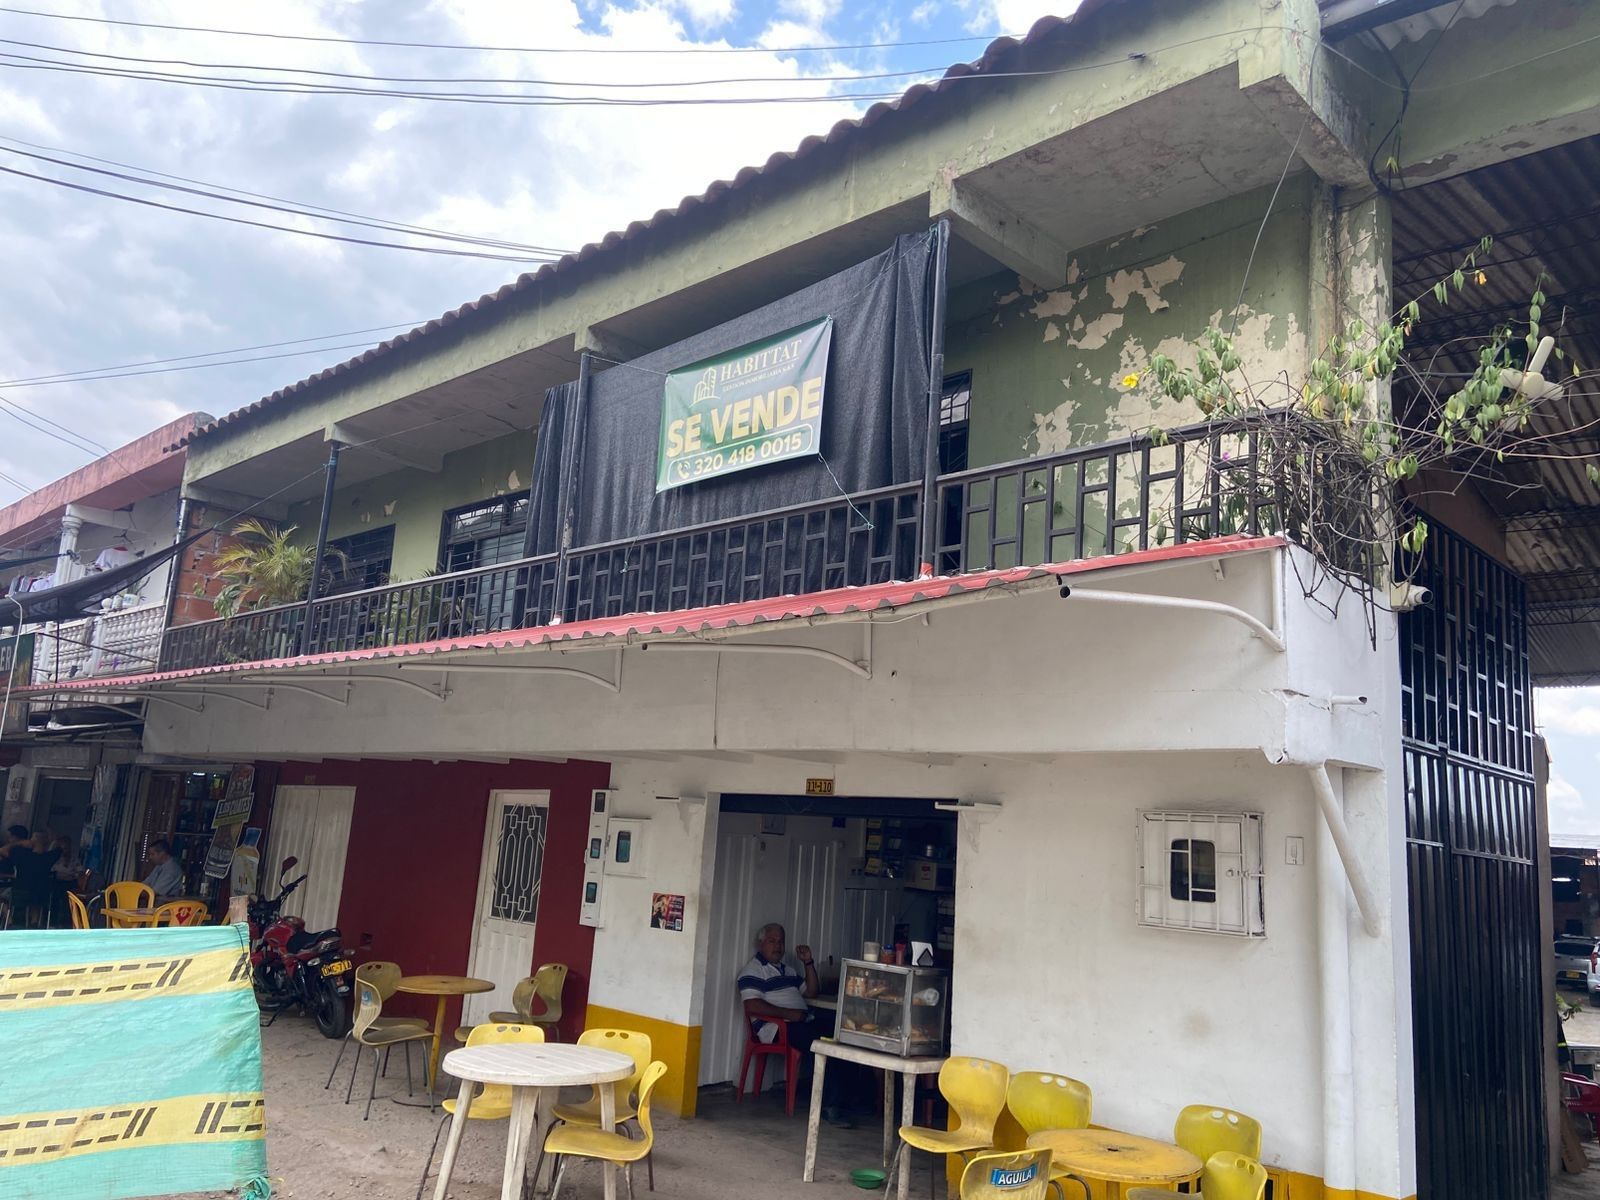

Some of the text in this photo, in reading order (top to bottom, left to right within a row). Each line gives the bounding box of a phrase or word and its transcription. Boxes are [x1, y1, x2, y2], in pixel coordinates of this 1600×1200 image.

[721, 340, 802, 381] HABITTAT
[667, 377, 822, 457] SE VENDE
[694, 433, 802, 475] 320 418 0015
[998, 1169, 1032, 1185] AGUILA
